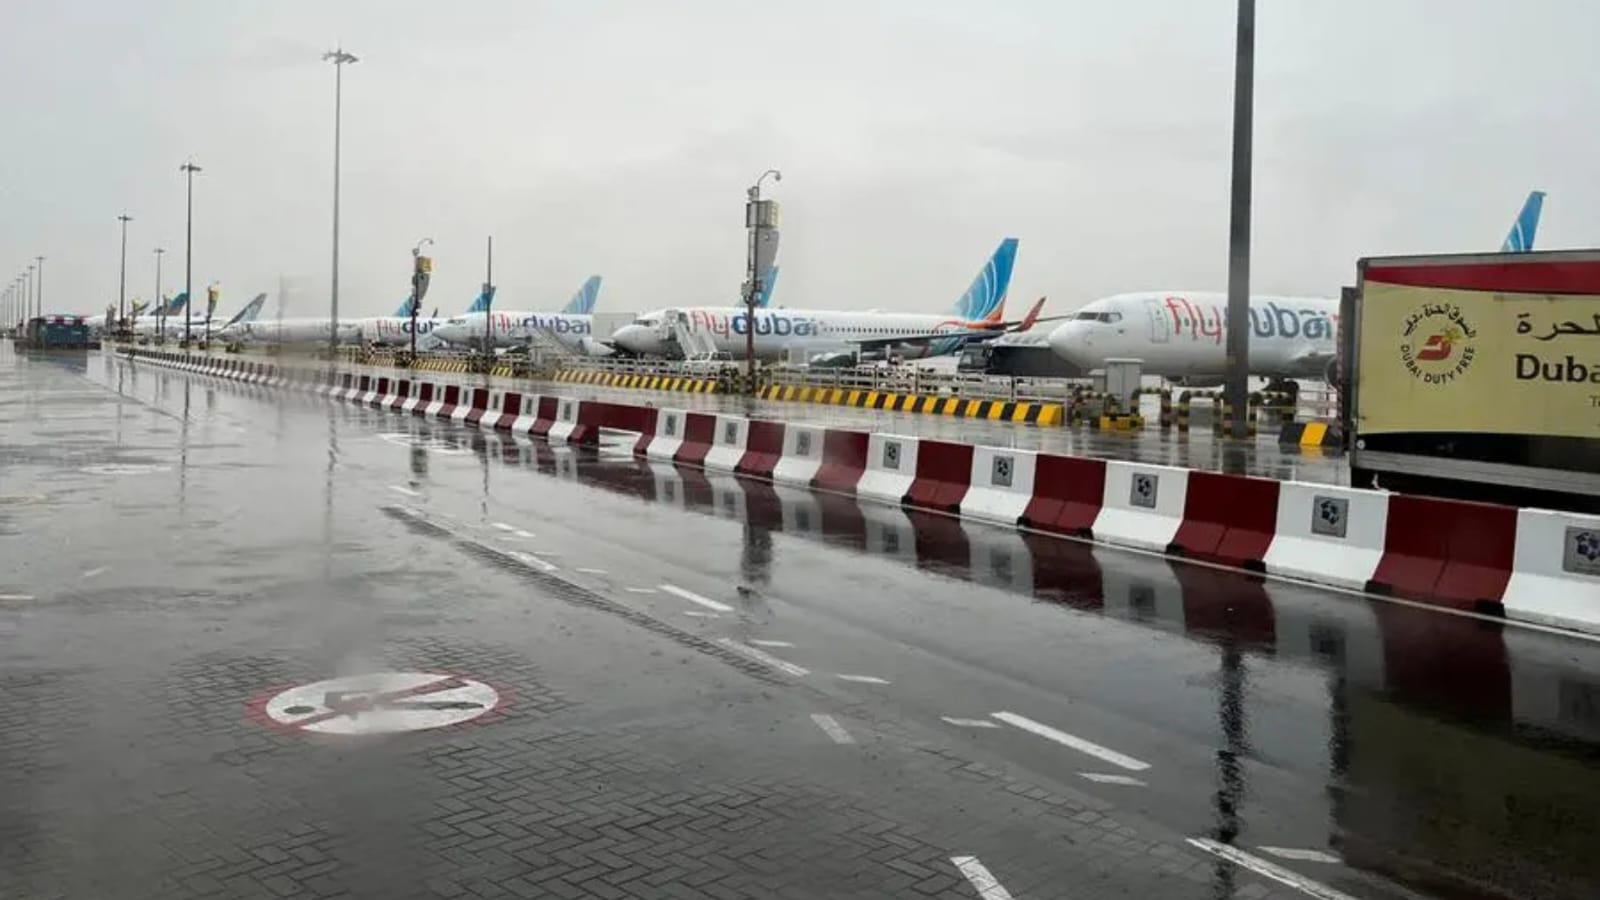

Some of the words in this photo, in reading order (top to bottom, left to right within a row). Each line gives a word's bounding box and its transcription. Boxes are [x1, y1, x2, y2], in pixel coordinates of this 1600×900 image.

[1165, 295, 1332, 345] flyubai
[1400, 344, 1422, 378] DUBAI
[1424, 370, 1455, 384] DUTY
[1456, 346, 1475, 375] FREE
